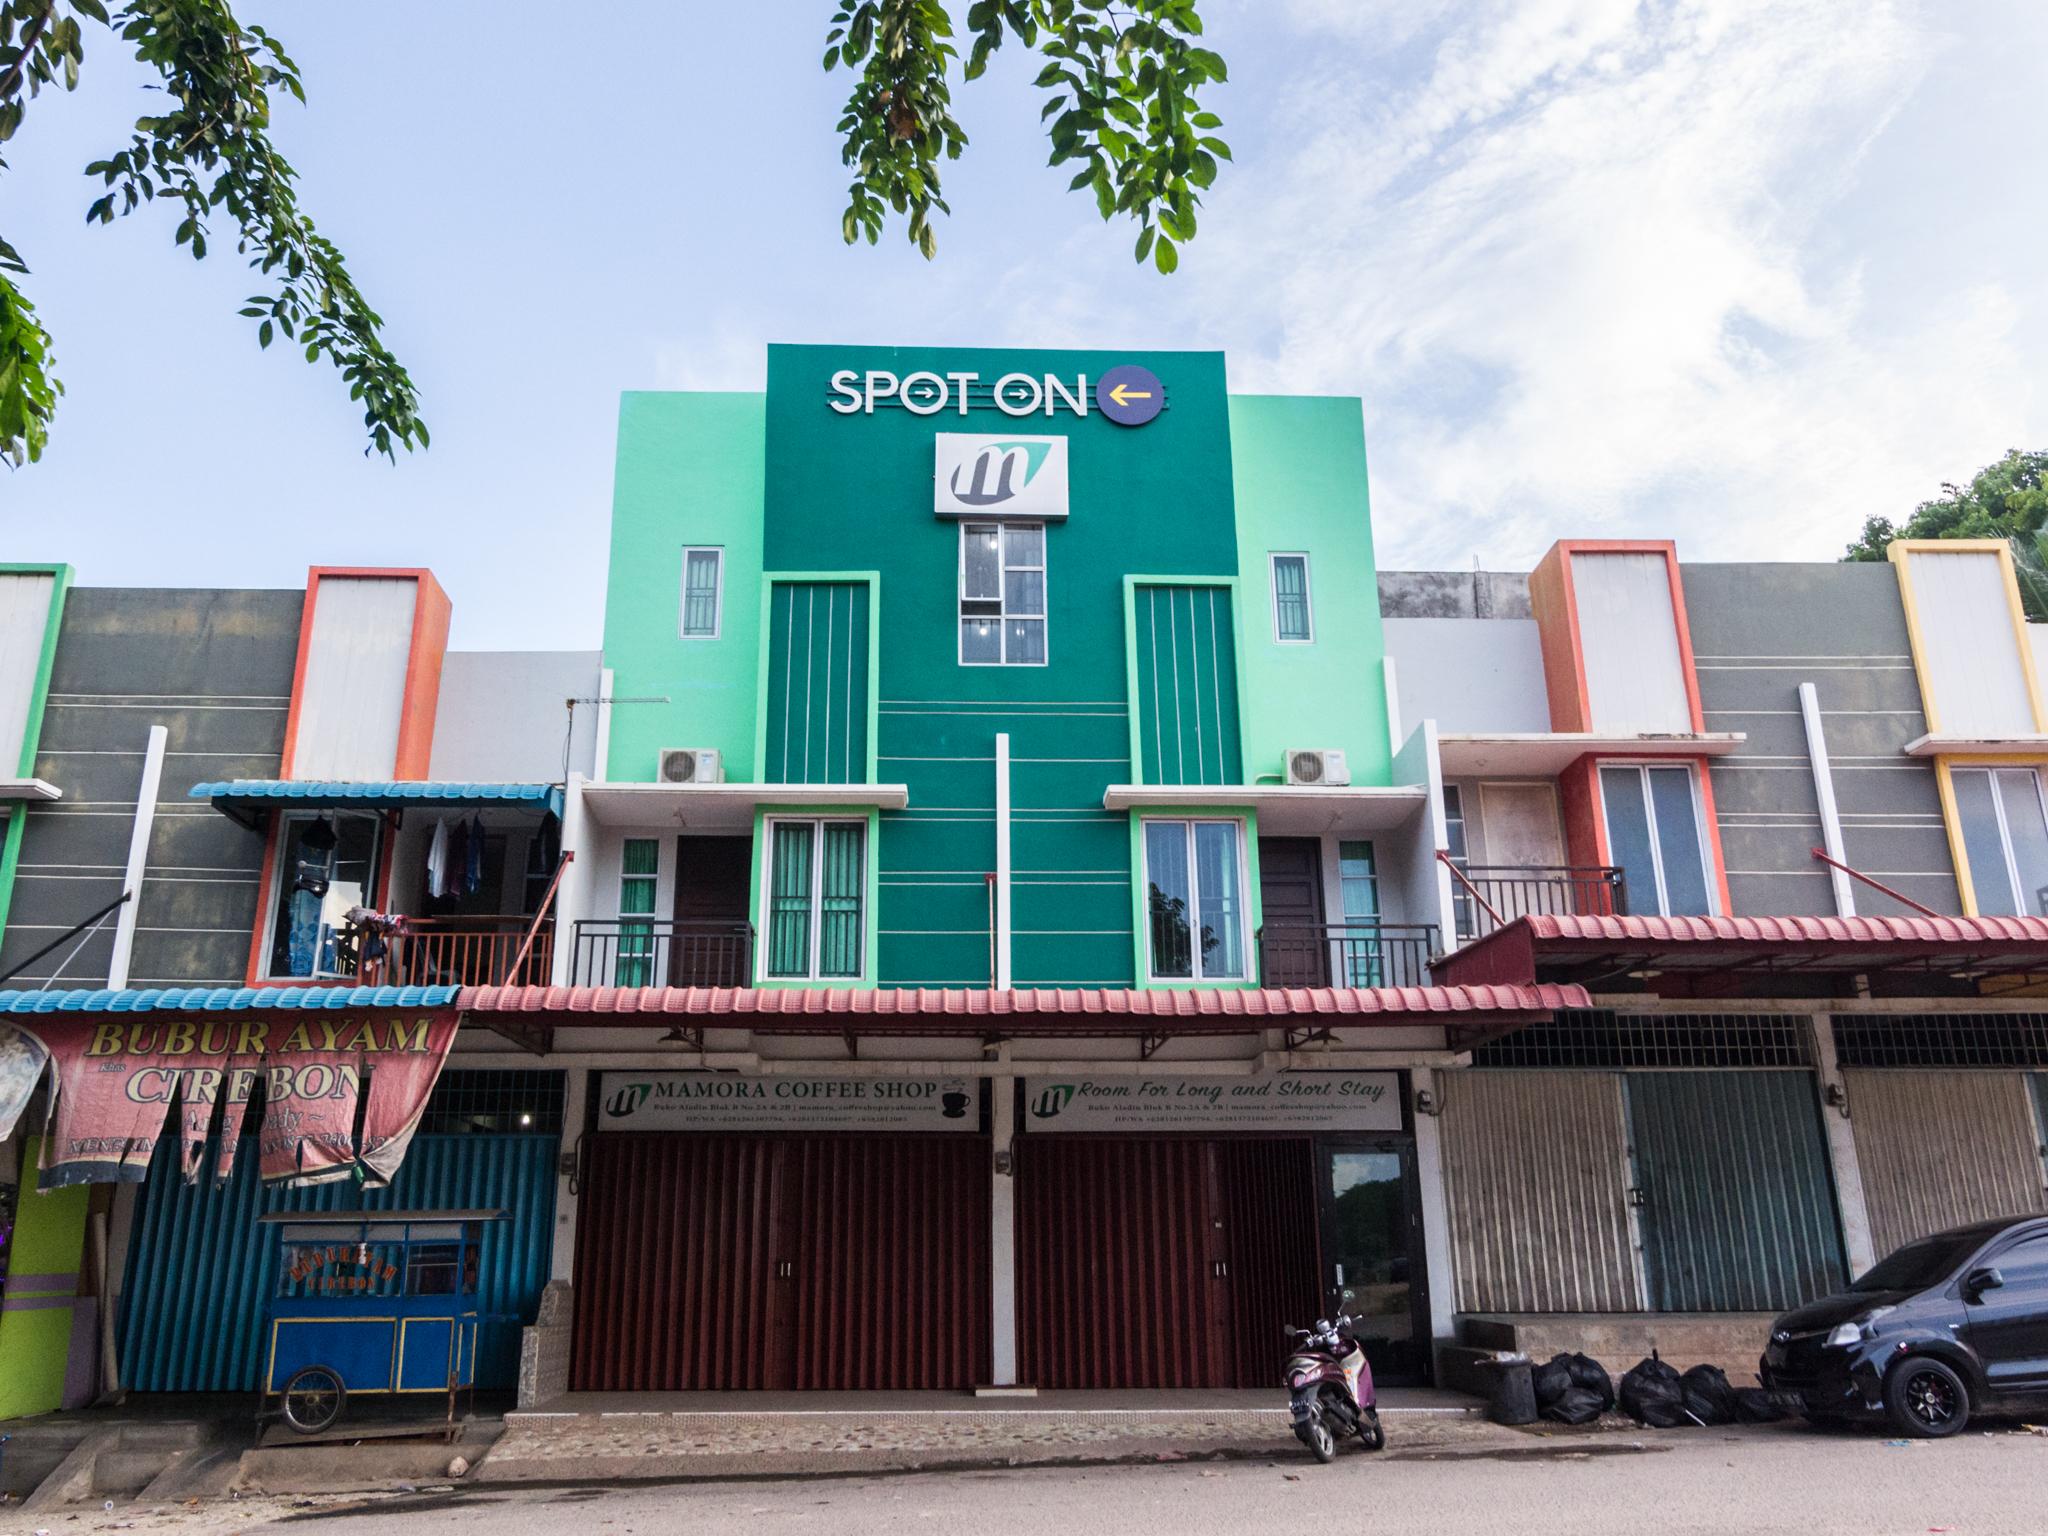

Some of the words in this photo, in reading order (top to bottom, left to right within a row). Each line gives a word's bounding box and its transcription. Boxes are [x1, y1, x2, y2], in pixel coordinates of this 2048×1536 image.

[830, 370, 979, 416] SPOT
[993, 372, 1088, 417] ON
[85, 1020, 268, 1056] BUBUR
[278, 1018, 432, 1054] AYAM
[99, 1062, 127, 1073] Khas
[655, 1081, 767, 1098] MAMORA
[775, 1081, 866, 1098] COFFEE
[874, 1081, 937, 1098] SHOP
[1078, 1081, 1131, 1097] Room
[1138, 1081, 1169, 1097] For
[1176, 1081, 1223, 1104] Long
[1231, 1081, 1272, 1096] and
[1277, 1080, 1331, 1096] Short
[1338, 1080, 1386, 1103] Stay
